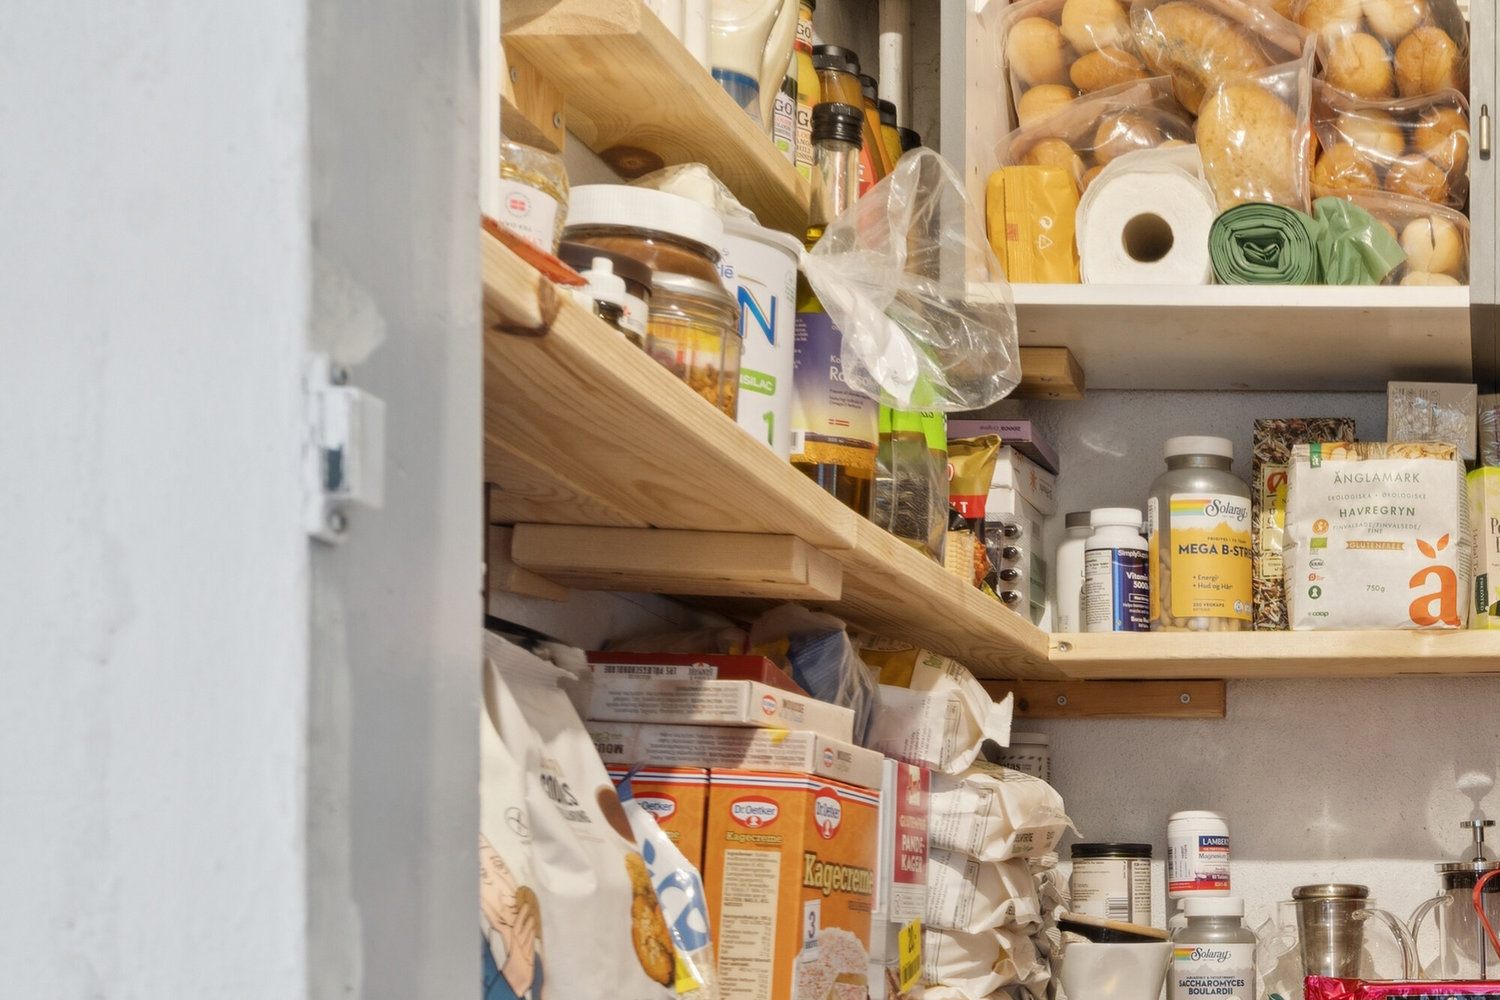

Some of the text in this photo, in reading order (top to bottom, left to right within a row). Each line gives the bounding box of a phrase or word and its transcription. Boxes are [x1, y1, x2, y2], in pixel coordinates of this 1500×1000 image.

[1333, 471, 1421, 485] ÄNGLAMARK
[1327, 491, 1427, 501] EKOLOGISKA ØKOLOGISKE
[1205, 499, 1248, 522] Solaray
[1339, 506, 1416, 518] HAVREGRYN
[1178, 543, 1219, 555] MEGA
[1312, 610, 1330, 618] coop
[725, 830, 783, 845] Kagecreme
[803, 852, 874, 897] Kagecreme
[807, 910, 817, 939] 3
[1190, 946, 1232, 963] Solaray
[1178, 979, 1245, 988] SACCHAROMYCES
[1188, 986, 1234, 996] BOULARDII
